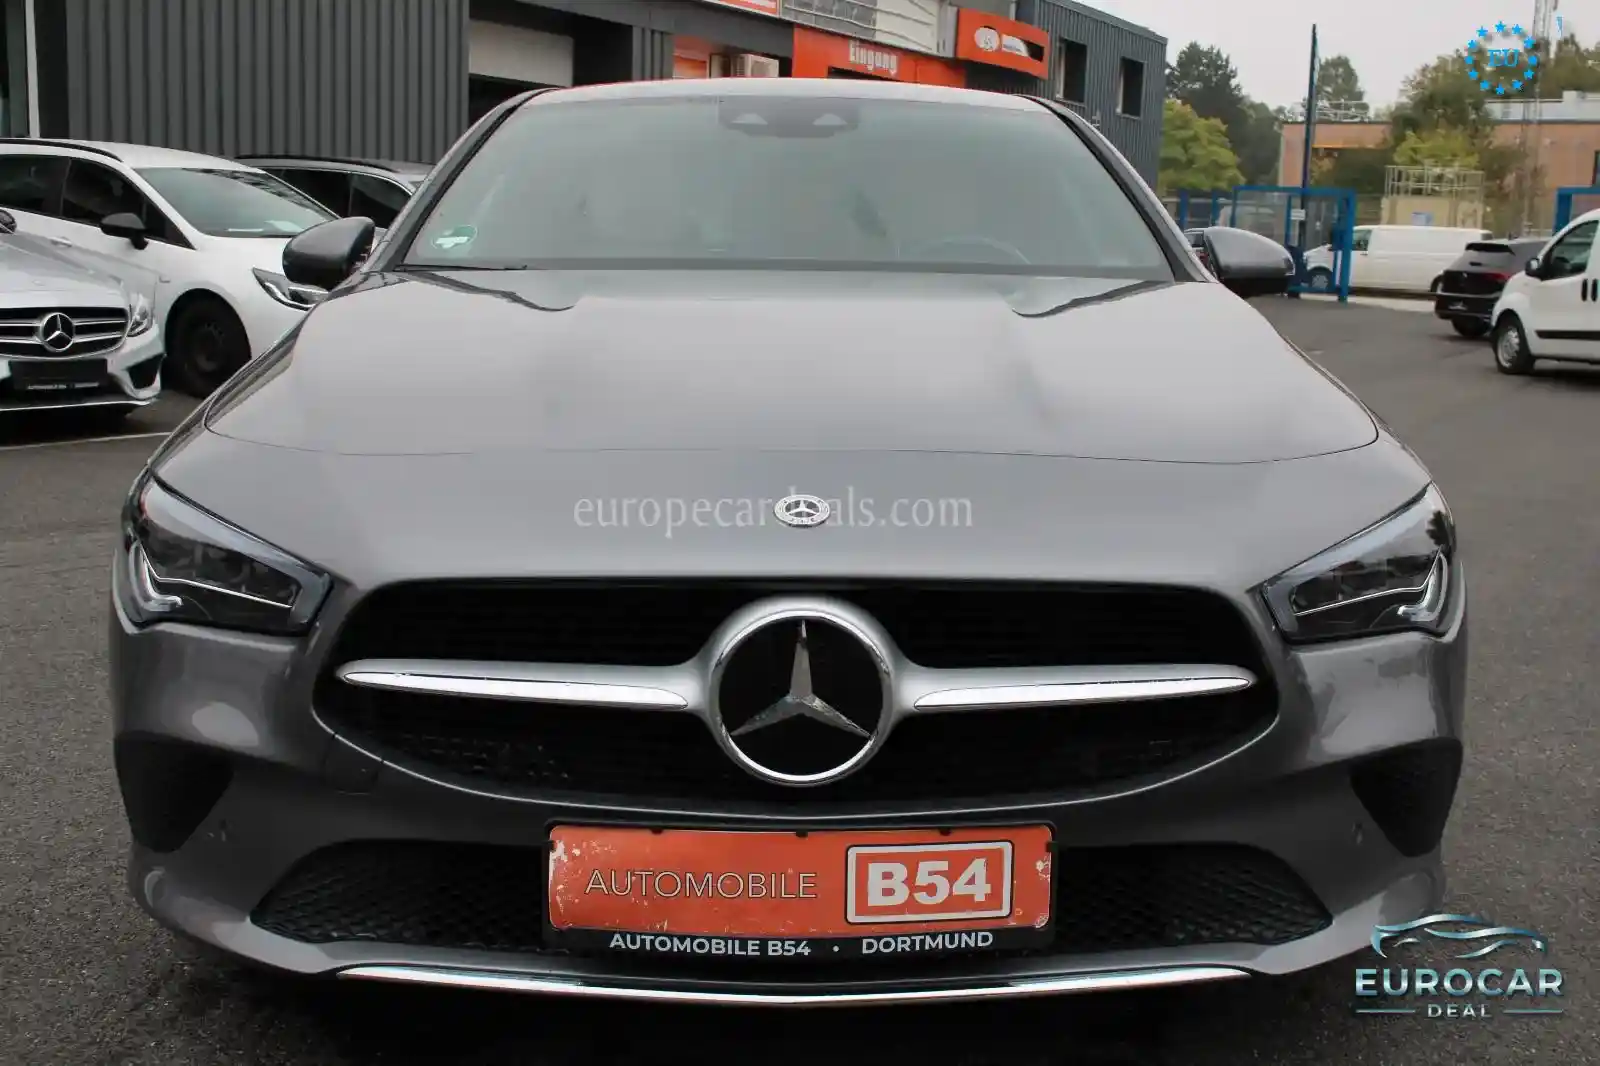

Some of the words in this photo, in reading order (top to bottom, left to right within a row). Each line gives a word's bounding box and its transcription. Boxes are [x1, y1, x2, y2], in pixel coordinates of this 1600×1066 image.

[584, 869, 817, 898] AUTOMOBILE
[867, 857, 992, 906] B54
[609, 933, 760, 956] AUTOMOBILE
[767, 940, 811, 956] B54
[862, 931, 993, 954] DORTMUND
